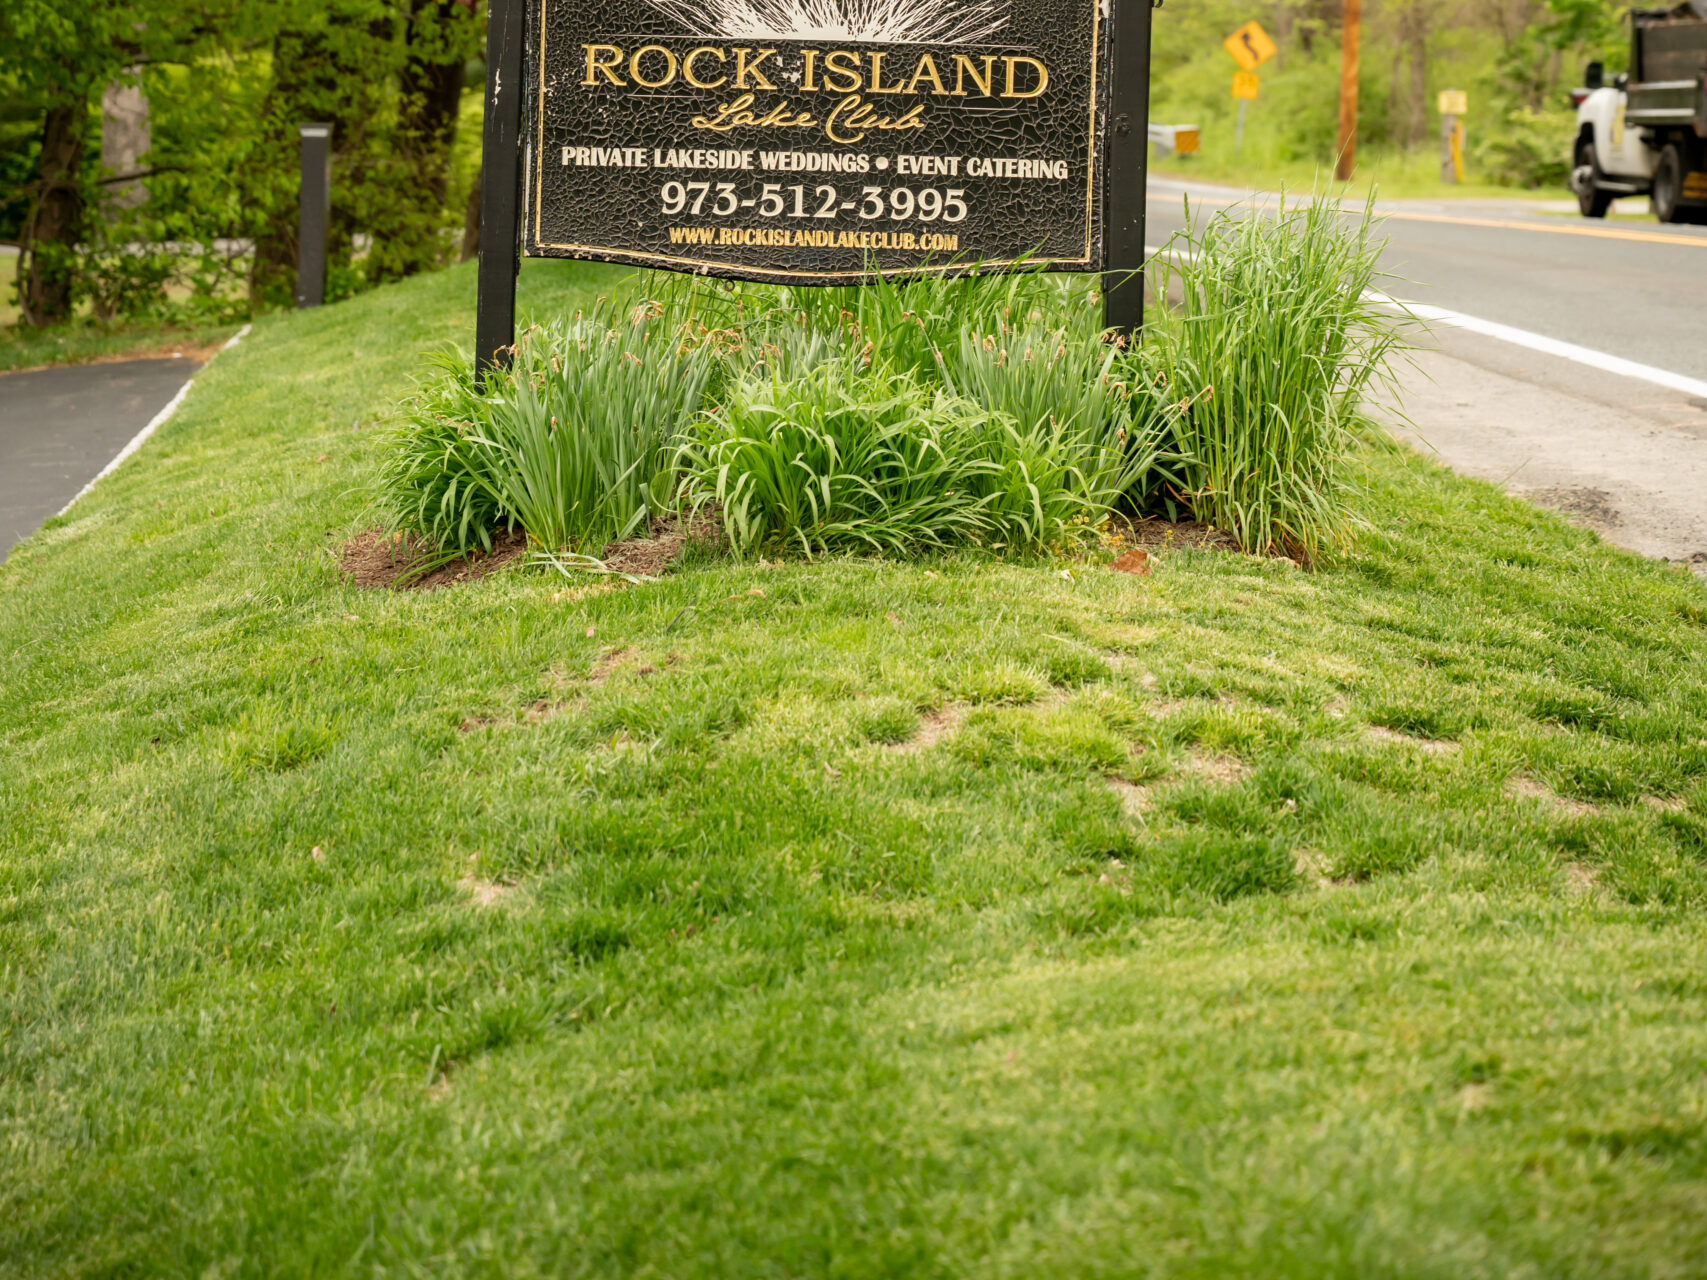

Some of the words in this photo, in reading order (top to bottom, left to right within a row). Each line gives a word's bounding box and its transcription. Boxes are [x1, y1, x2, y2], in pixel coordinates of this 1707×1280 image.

[580, 43, 778, 90] ROCK
[799, 49, 1049, 98] ISLAND
[691, 92, 818, 131] Lake
[825, 93, 925, 144] Club
[561, 146, 648, 167] PRIVATE
[653, 148, 754, 170] LAKESIDE
[759, 150, 870, 173] WEDDINGS
[897, 154, 961, 176] EVENT
[966, 157, 1069, 180] CATERING
[660, 181, 968, 222] 973-512-3995
[669, 227, 958, 251] WWW.ROCKISLANDLAKECLUB.COM
